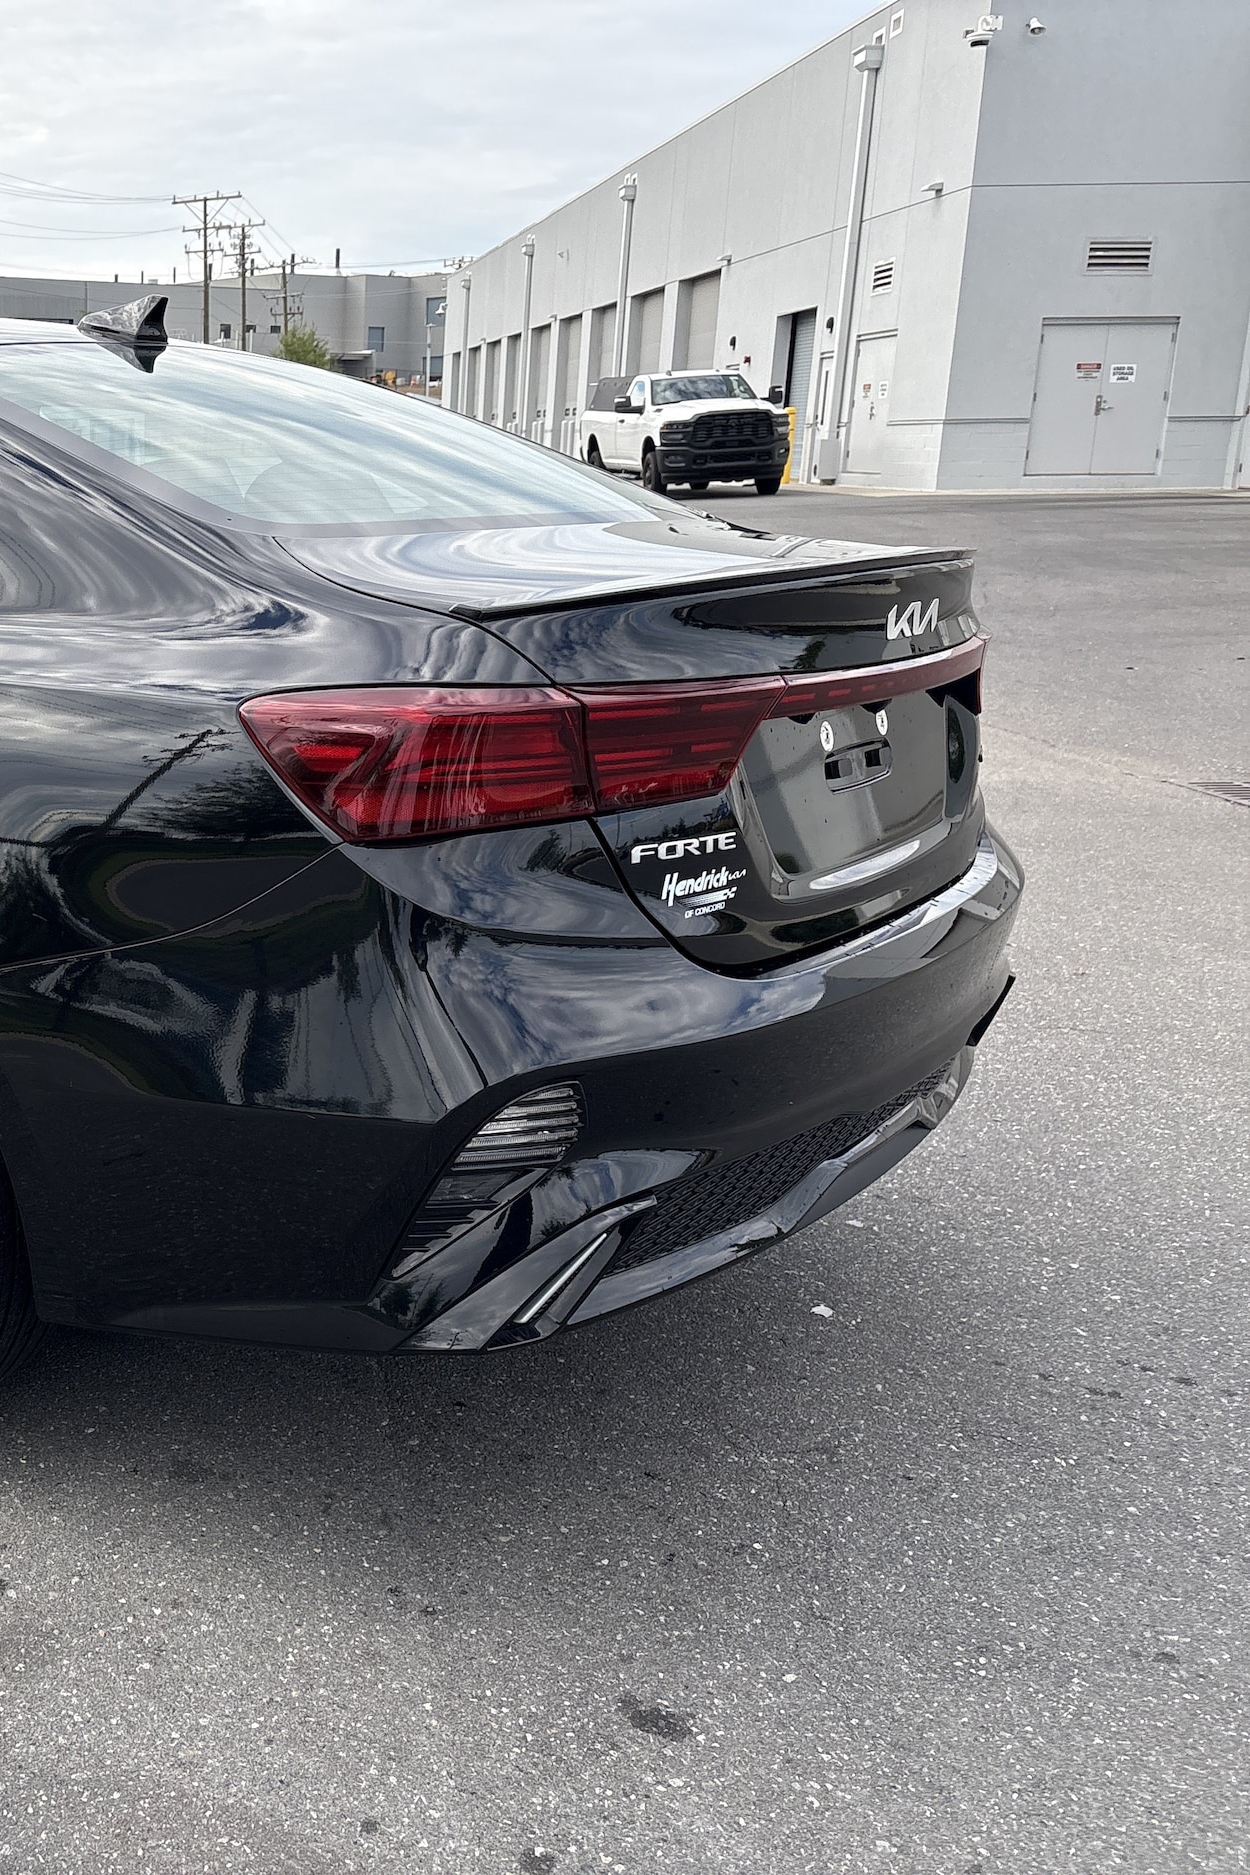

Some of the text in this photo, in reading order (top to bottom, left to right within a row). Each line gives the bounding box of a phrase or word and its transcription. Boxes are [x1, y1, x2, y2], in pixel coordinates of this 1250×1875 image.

[887, 598, 939, 639] KIA
[631, 832, 736, 864] FORTE
[661, 866, 730, 907] Hendrick
[684, 902, 726, 919] OF CONCORD
